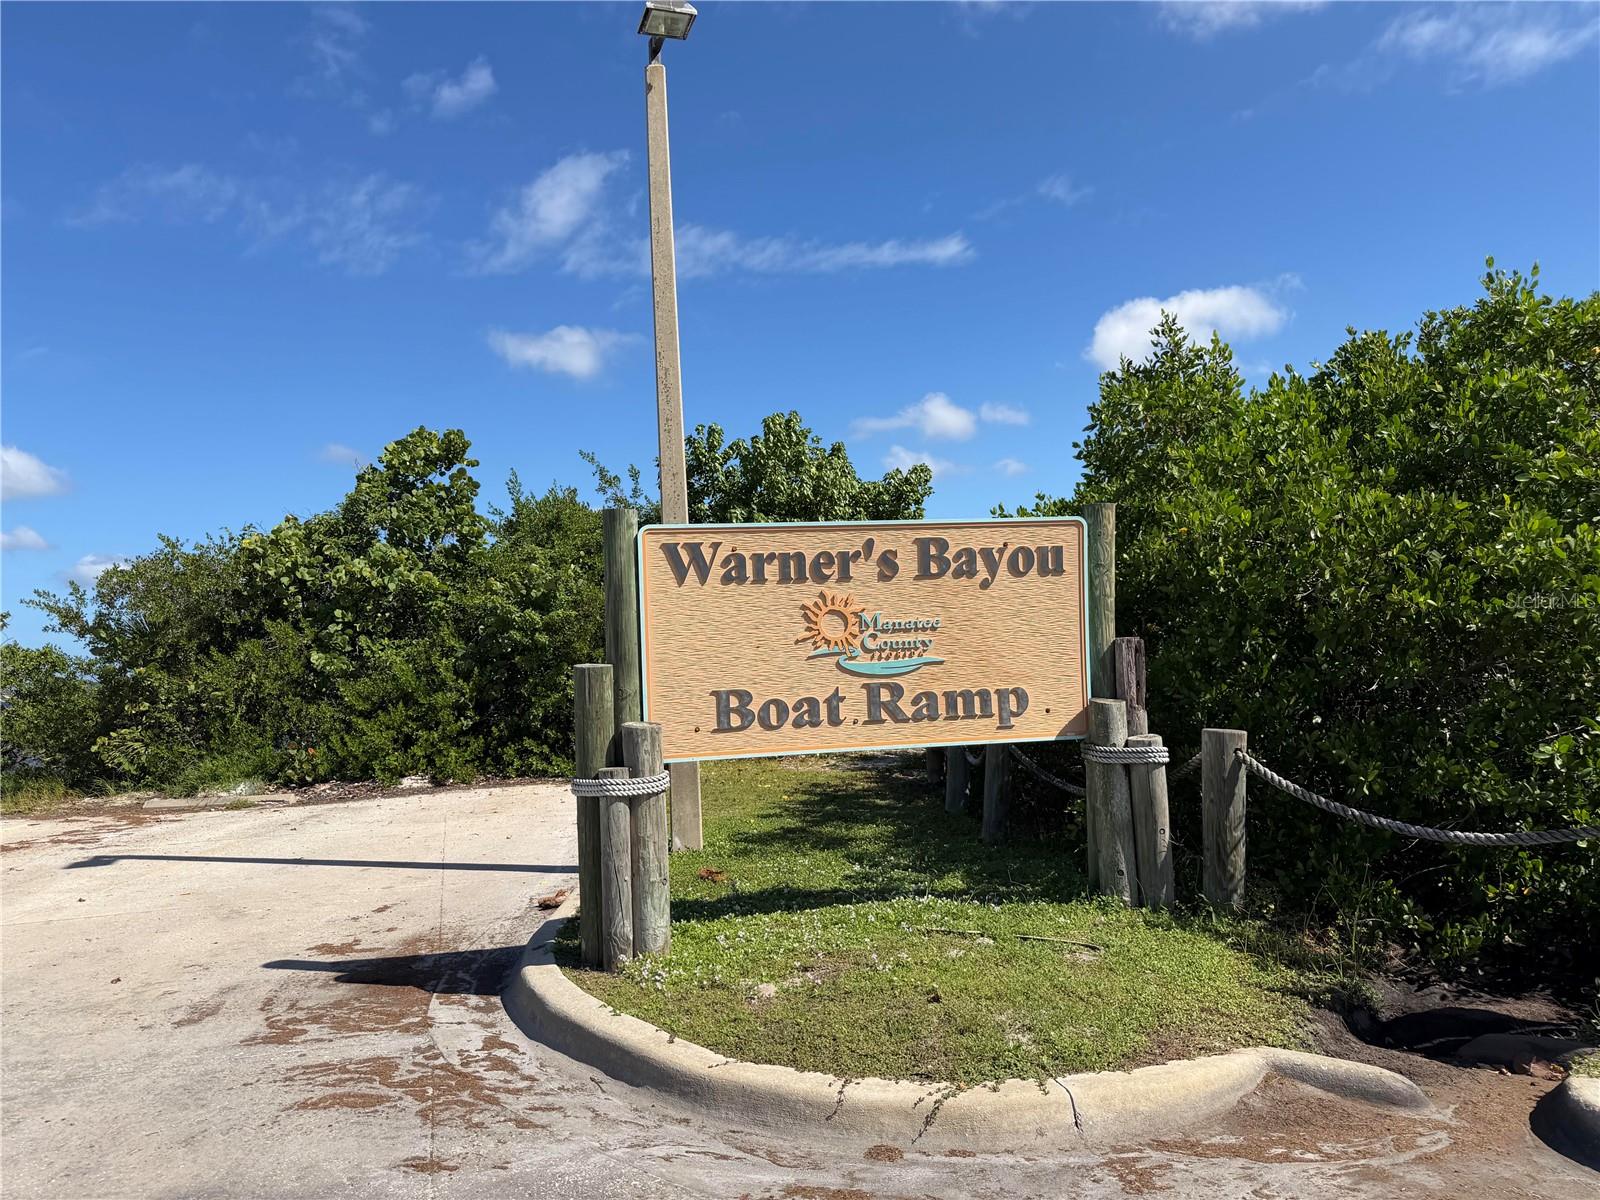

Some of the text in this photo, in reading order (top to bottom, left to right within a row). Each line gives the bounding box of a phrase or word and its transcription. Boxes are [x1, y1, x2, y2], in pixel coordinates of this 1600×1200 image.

[661, 537, 1066, 589] Warner's Bayou
[858, 611, 941, 633] Manatee
[861, 631, 934, 652] County
[711, 682, 1029, 734] Boat Ramp
